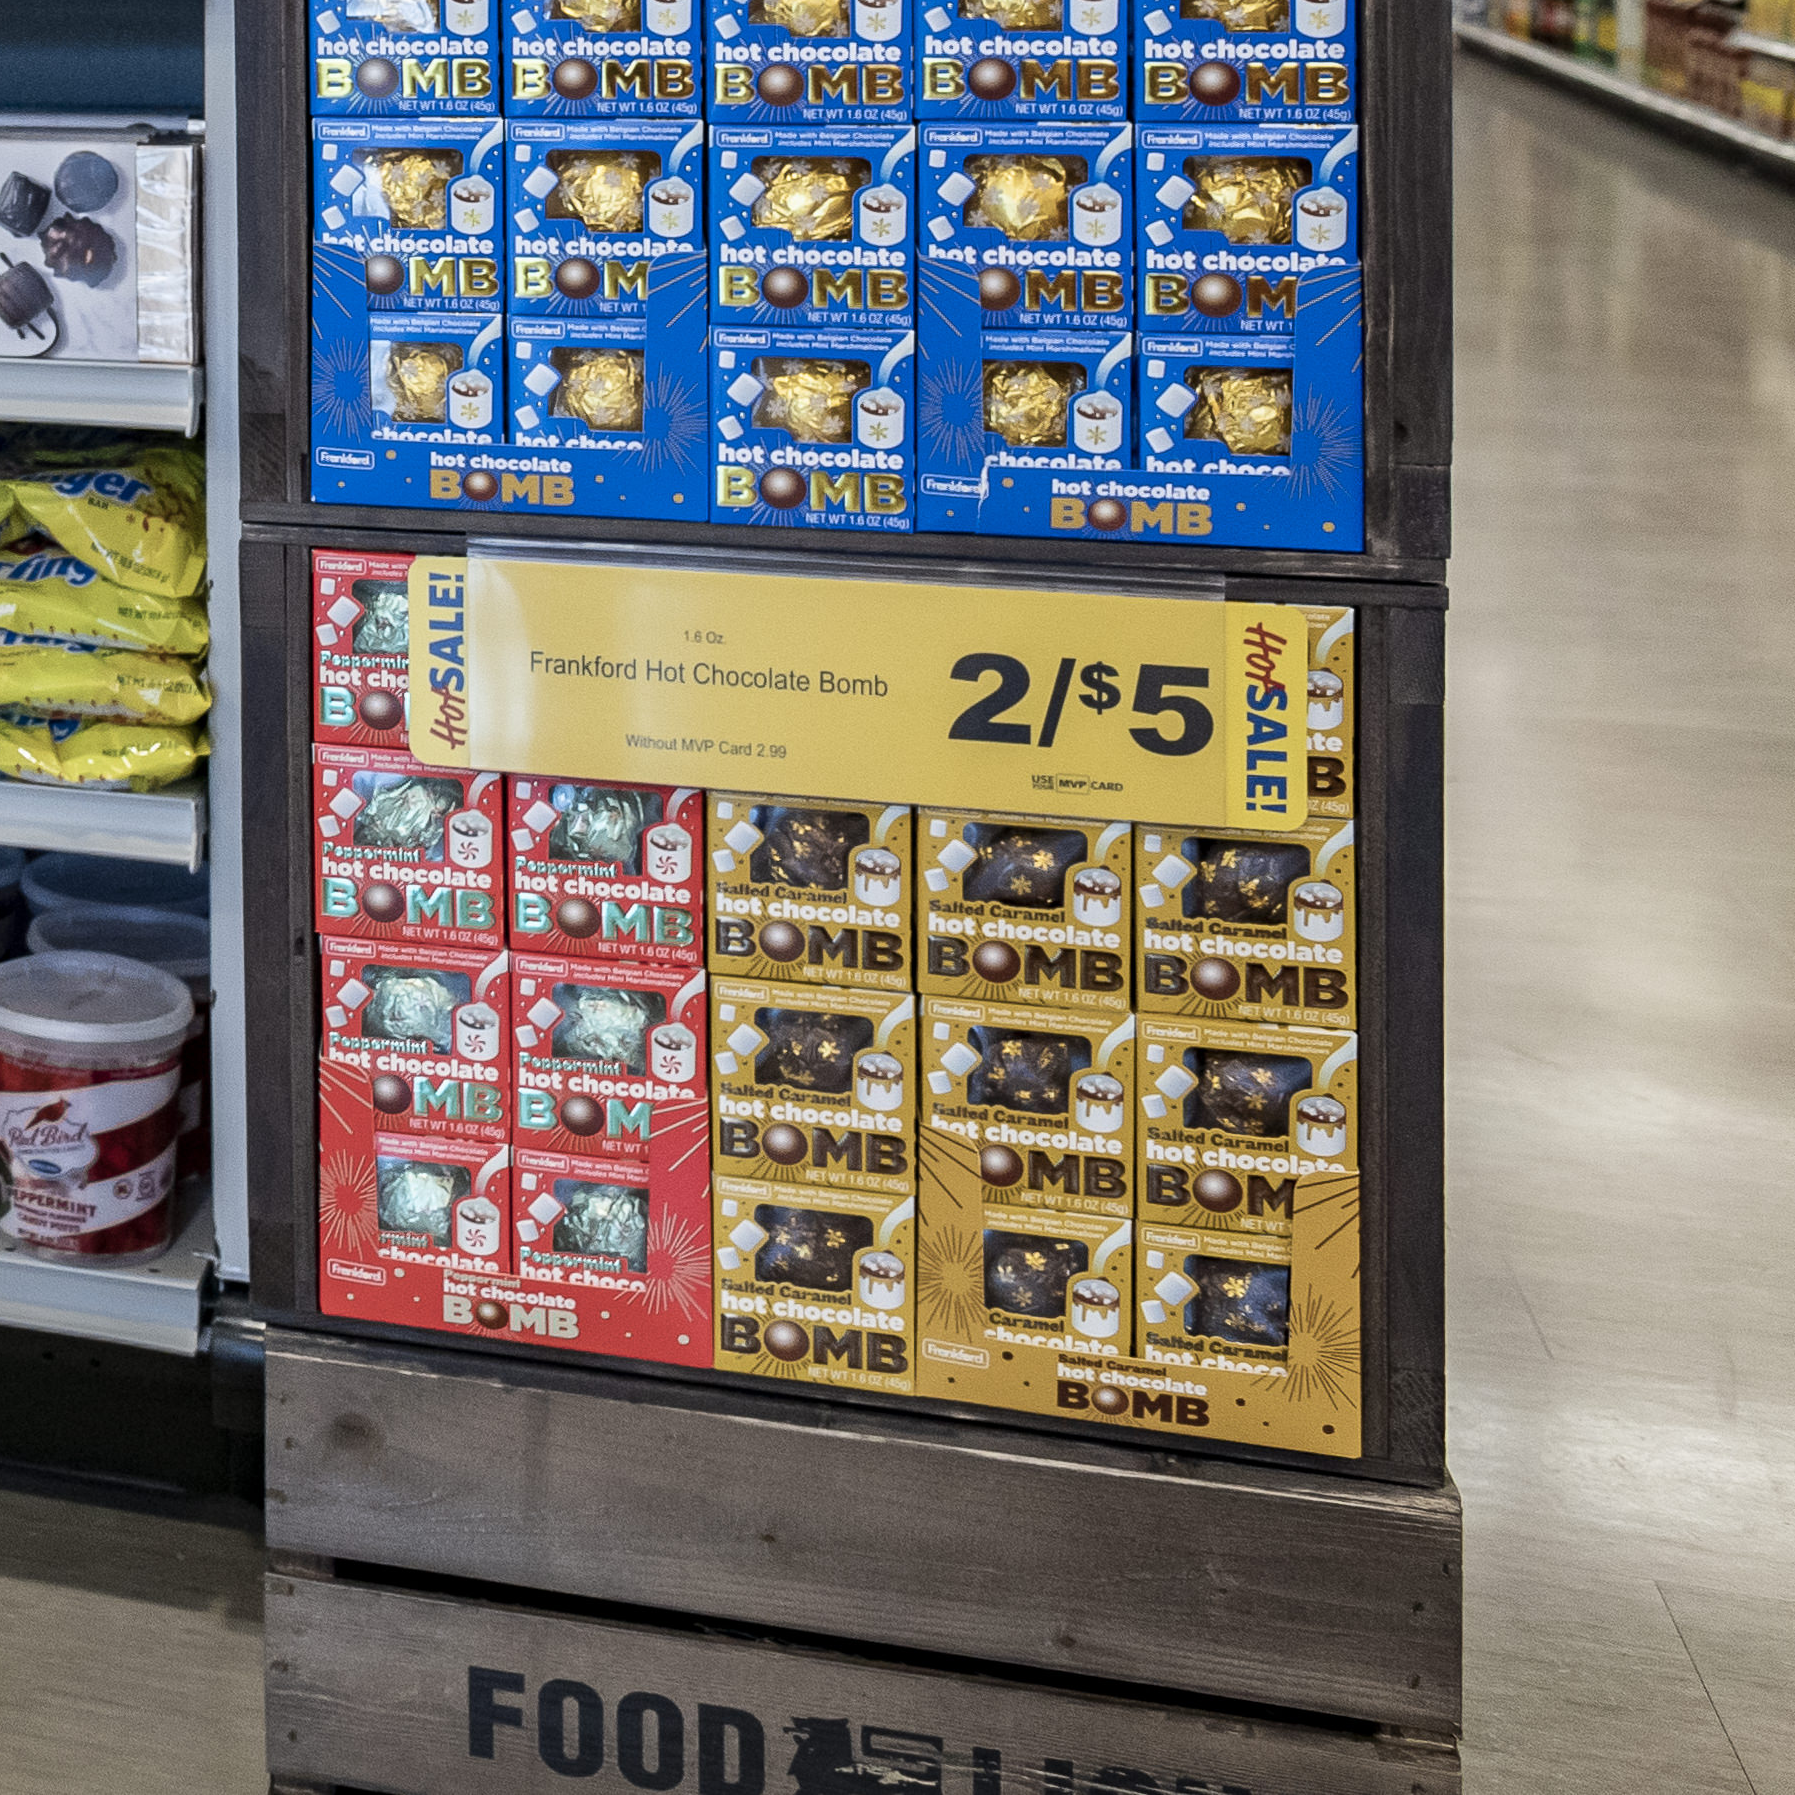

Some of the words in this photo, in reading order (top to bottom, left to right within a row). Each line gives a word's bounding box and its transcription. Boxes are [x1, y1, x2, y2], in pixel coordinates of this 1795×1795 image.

[430, 451, 466, 468] hot
[470, 453, 572, 473] chocolate
[428, 572, 464, 692] SALE!
[684, 630, 703, 644] 1.6
[704, 630, 726, 645] Oz.
[530, 652, 638, 684] Frankford
[644, 657, 687, 685] Hot
[693, 661, 811, 695] Chocolate
[818, 669, 889, 698] Bomb
[626, 733, 677, 755] Without
[681, 737, 712, 756] MVP
[715, 740, 752, 759] Card
[756, 741, 787, 760] 2.99
[1244, 682, 1289, 814] SALE!
[1032, 775, 1053, 783] USE
[1058, 780, 1088, 790] MVP
[1090, 782, 1123, 792] CARD
[322, 842, 419, 862] Peppermint
[928, 900, 986, 916] Salted
[990, 908, 1066, 923] Caramel
[467, 1666, 766, 1794] FOOD
